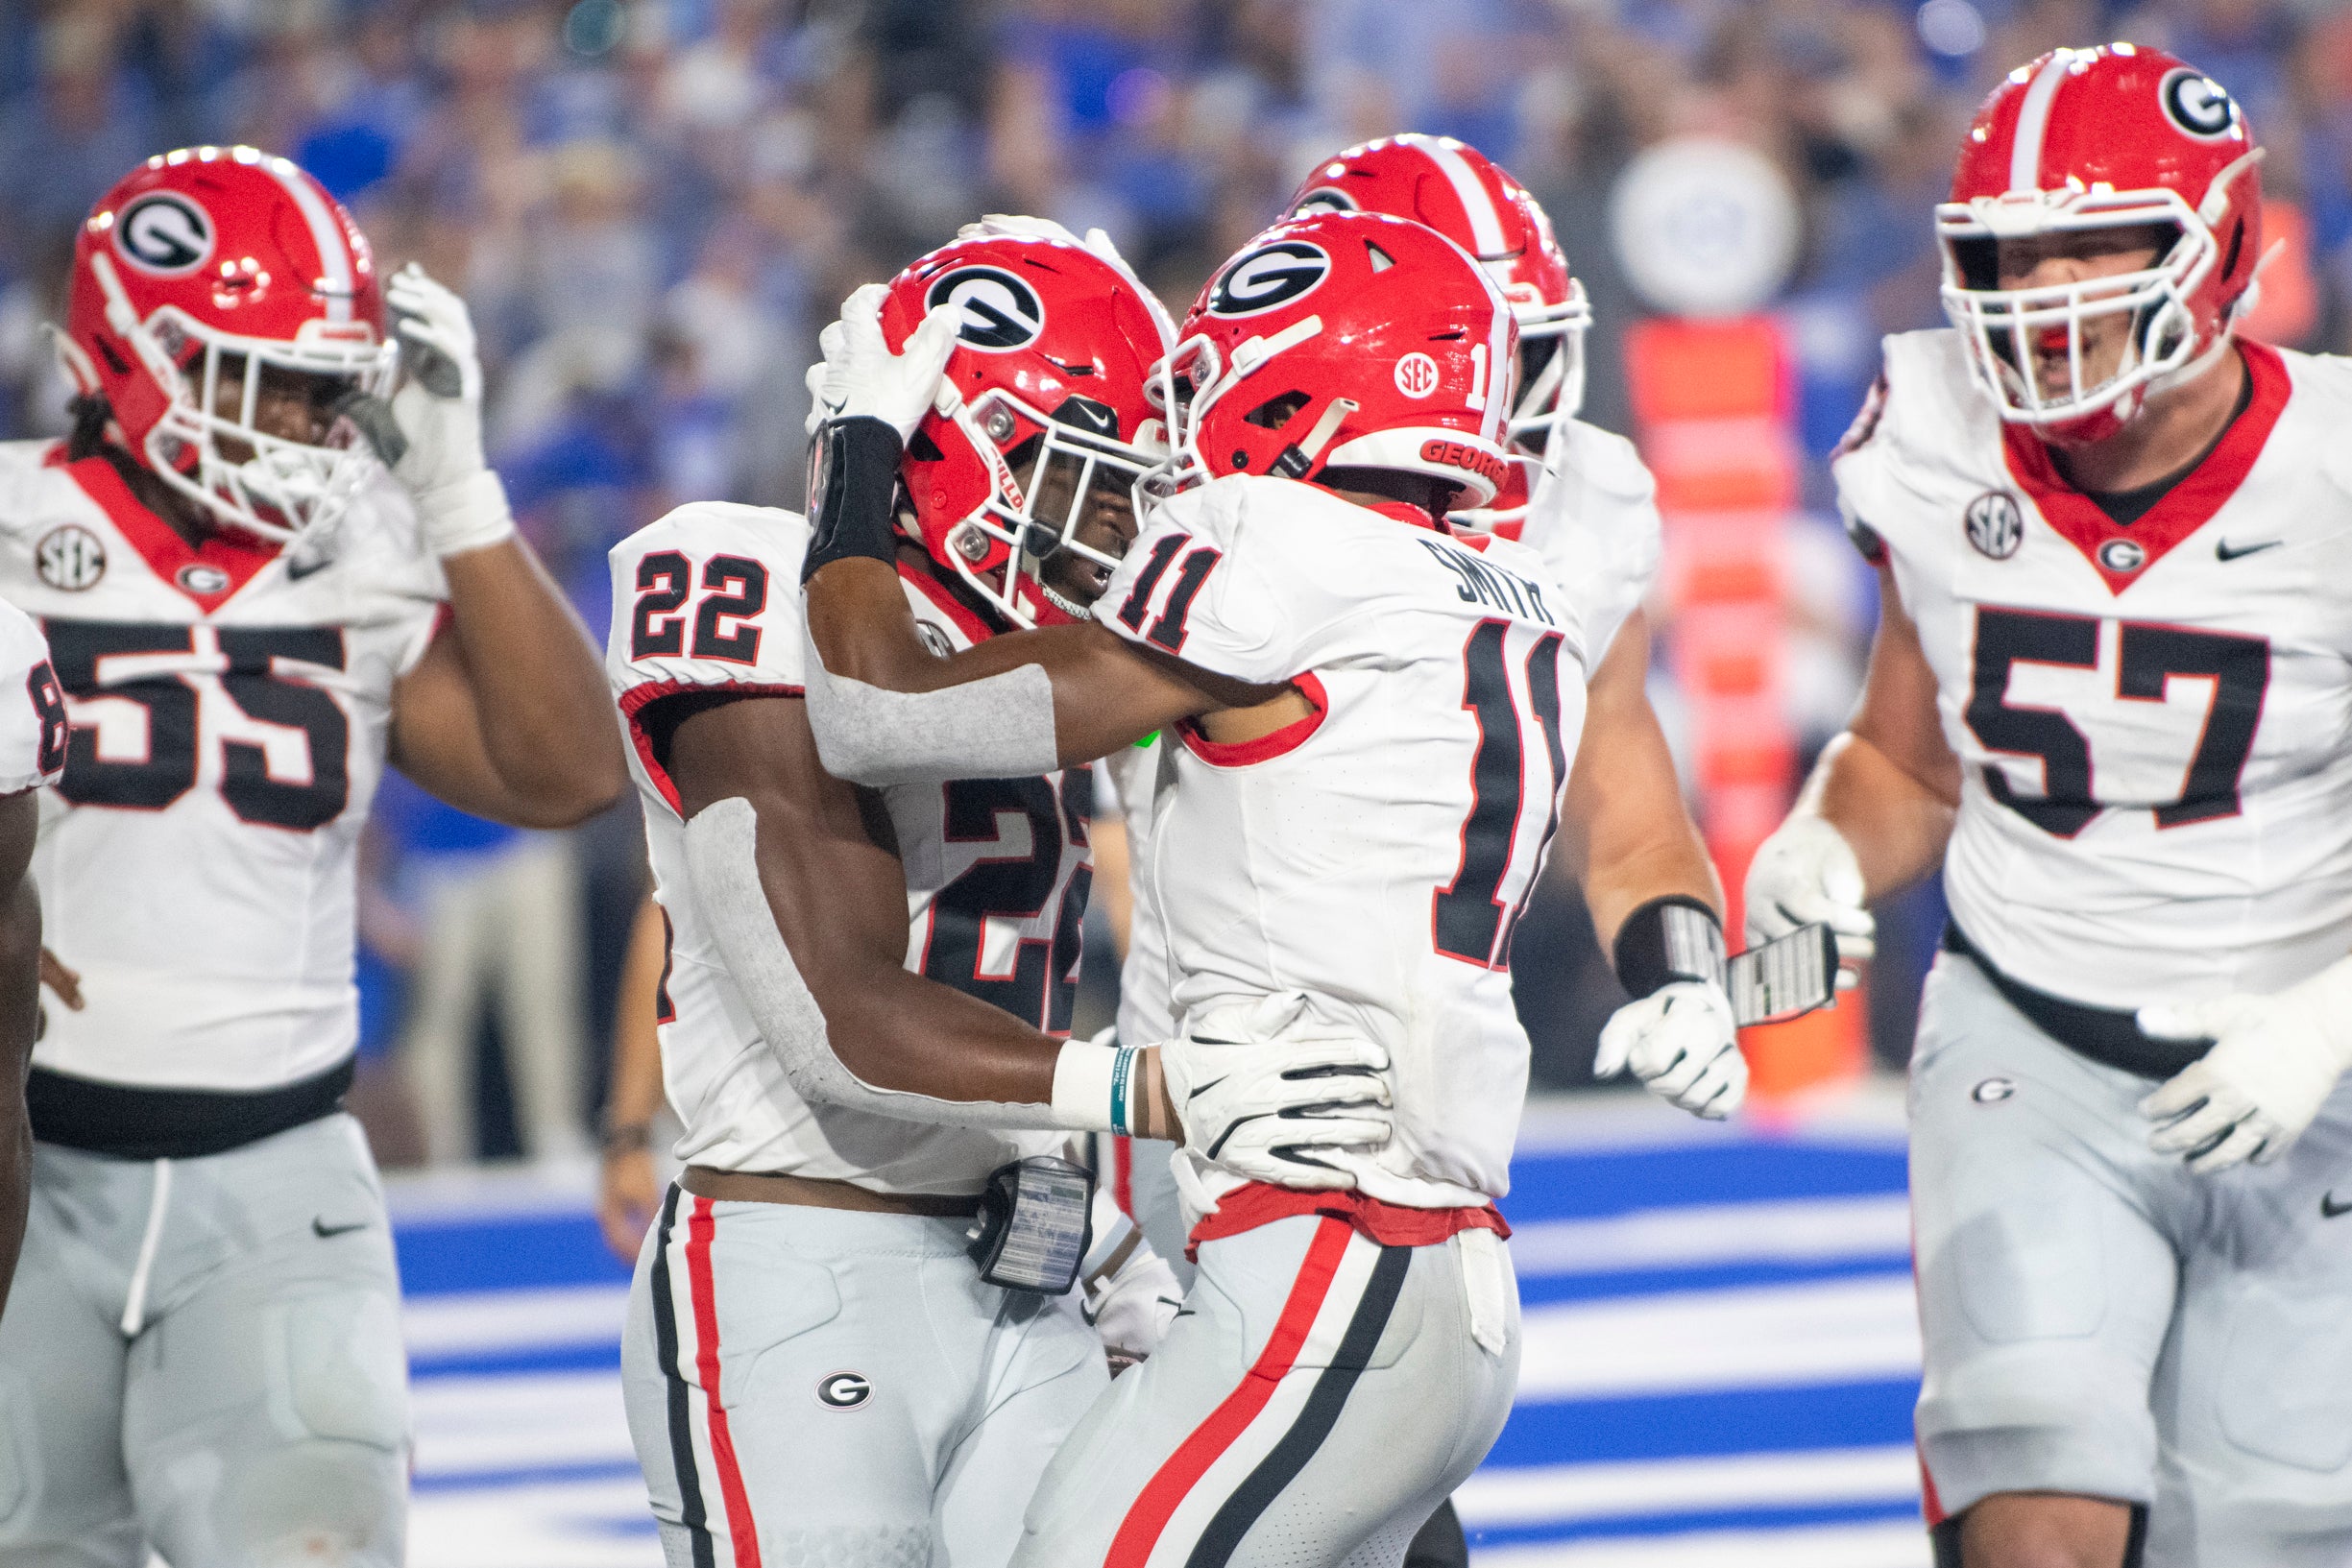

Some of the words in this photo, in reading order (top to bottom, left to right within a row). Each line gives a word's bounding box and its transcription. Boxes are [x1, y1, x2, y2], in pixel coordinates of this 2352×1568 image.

[2164, 73, 2233, 135] G
[118, 196, 208, 270] G
[927, 267, 1041, 349] G
[1211, 242, 1326, 315] G
[1397, 355, 1436, 395] SEC
[38, 528, 105, 591] SEC
[1967, 495, 2023, 558] SEC
[2097, 539, 2150, 571] G
[630, 549, 769, 667] 22
[1117, 534, 1223, 655] 11
[1416, 538, 1556, 627] SMITH
[26, 659, 70, 777] 8
[42, 617, 349, 832] 55
[1961, 604, 2271, 839] 57
[1432, 617, 1566, 972] 11
[1972, 1076, 2016, 1105] G
[816, 1372, 871, 1408] G
